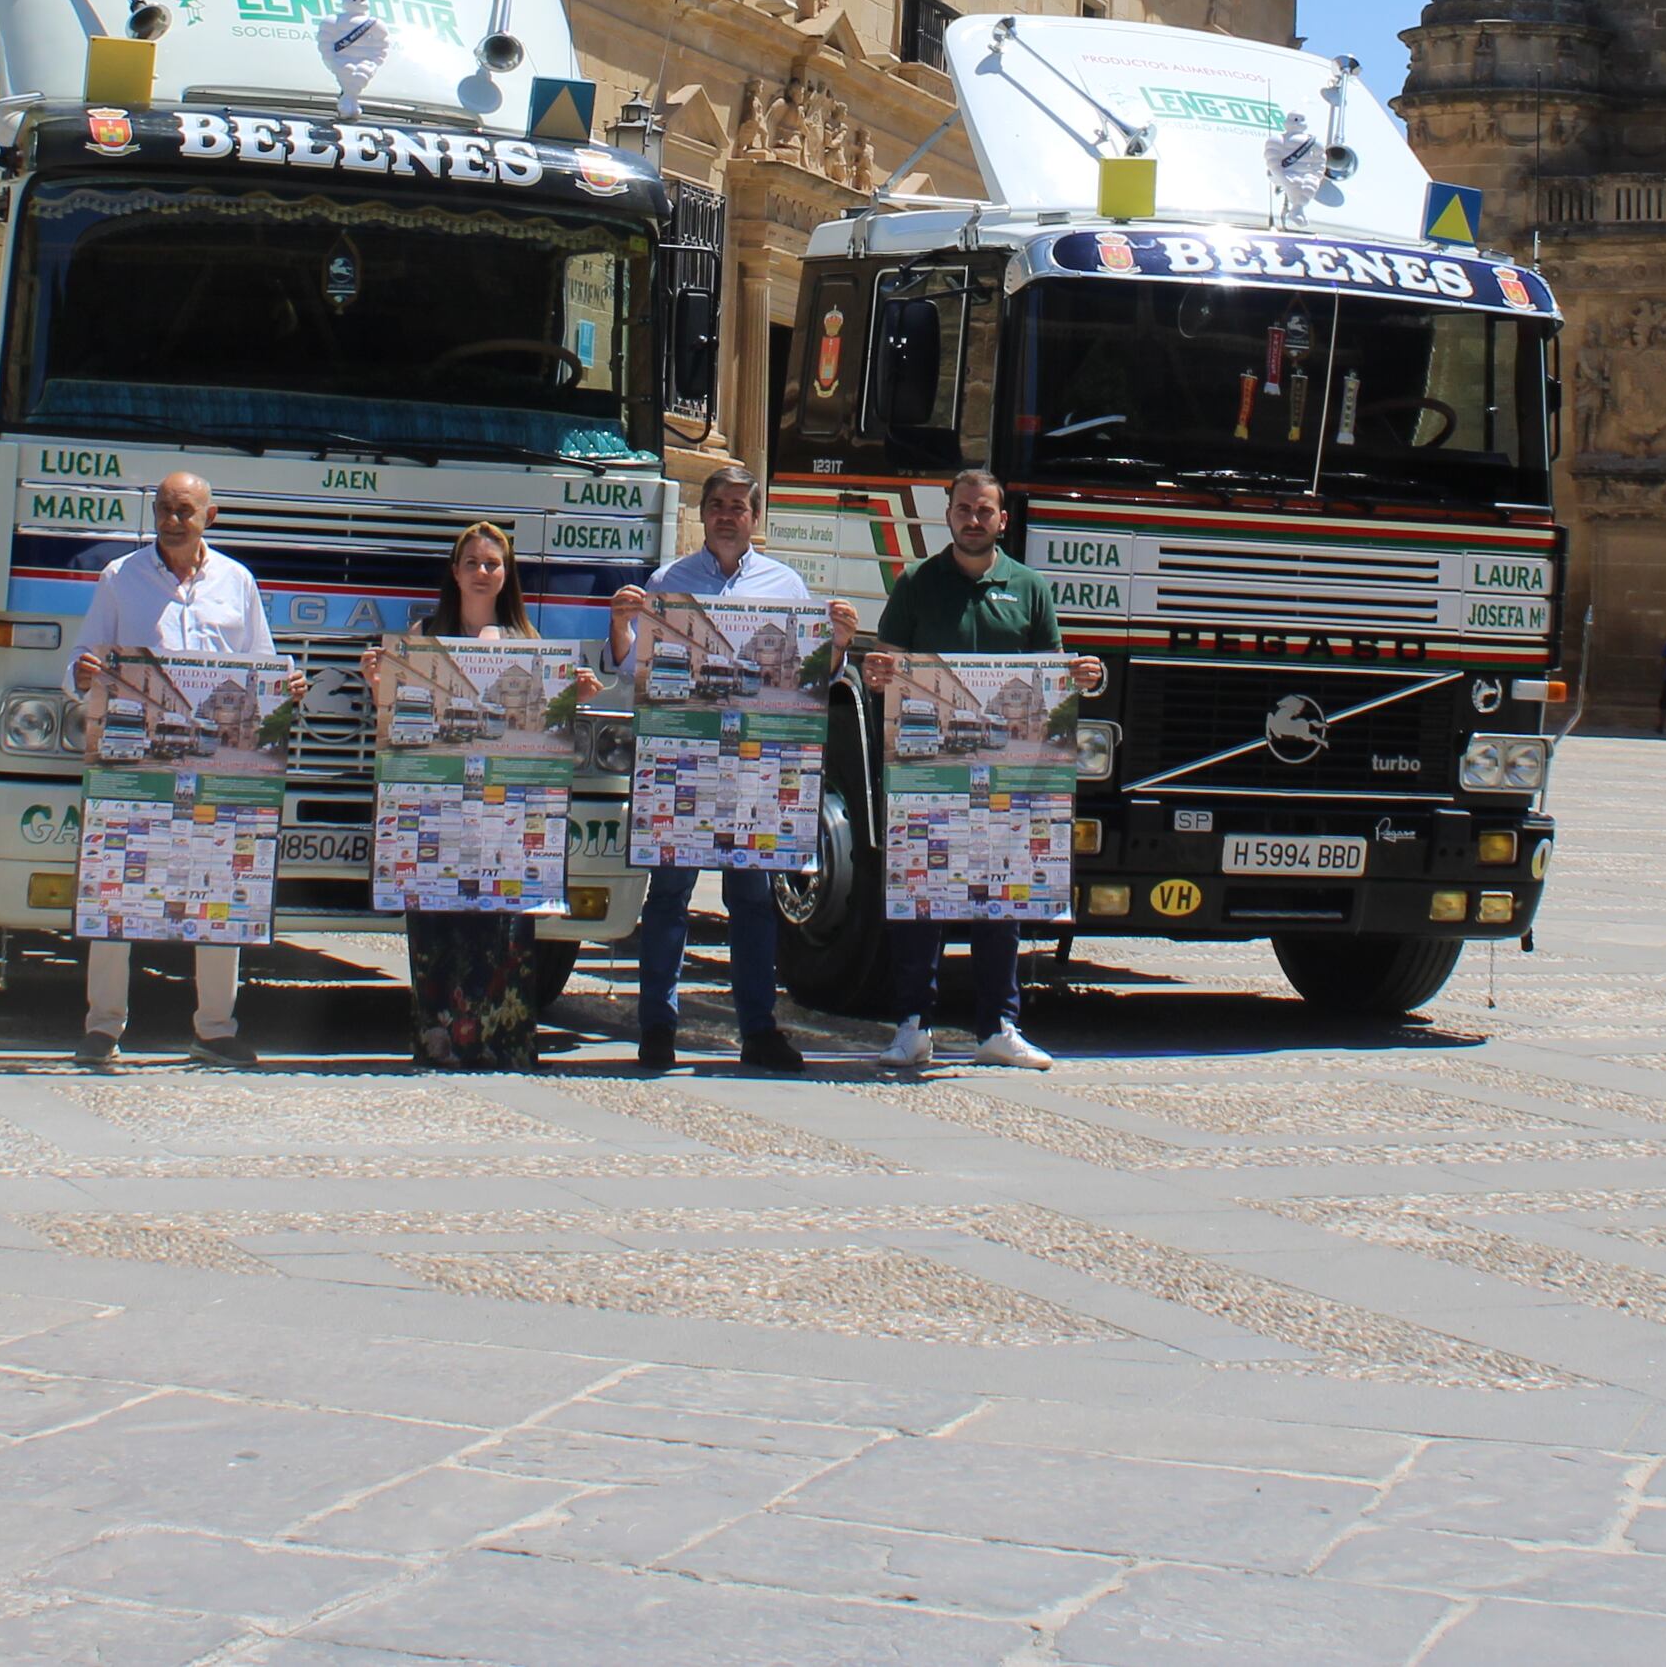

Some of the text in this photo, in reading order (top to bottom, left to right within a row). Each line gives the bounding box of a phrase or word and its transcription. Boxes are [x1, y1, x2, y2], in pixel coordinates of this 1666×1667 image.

[231, 25, 318, 43] SOCIEDA
[1080, 54, 1268, 84] PRODUCTOS ALIMENTICIOS
[173, 111, 544, 187] BELENES
[1155, 235, 1476, 299] BELENES
[40, 448, 123, 478] LUCIA
[812, 458, 844, 475] 1231T
[320, 468, 378, 494] JAEN
[32, 493, 126, 524] MARIA
[562, 480, 644, 511] LAURA
[551, 524, 623, 552] JOSEFA
[1047, 540, 1121, 568] LUCIA
[1474, 563, 1545, 592] LAURA
[1467, 602, 1525, 629] JOSEFA
[1168, 626, 1428, 662] PEGASO
[1039, 659, 1071, 670] CLÁSICO
[1371, 754, 1422, 773] turbo
[1178, 812, 1211, 830] SP
[532, 850, 564, 859] SCANIA
[1038, 855, 1070, 863] SCANIA
[1234, 841, 1362, 870] H 5994 BBD
[240, 873, 273, 881] SCANIA
[480, 867, 501, 878] TXT
[989, 872, 1010, 883] TXT
[188, 889, 210, 901] TXT
[1158, 885, 1194, 911] VH
